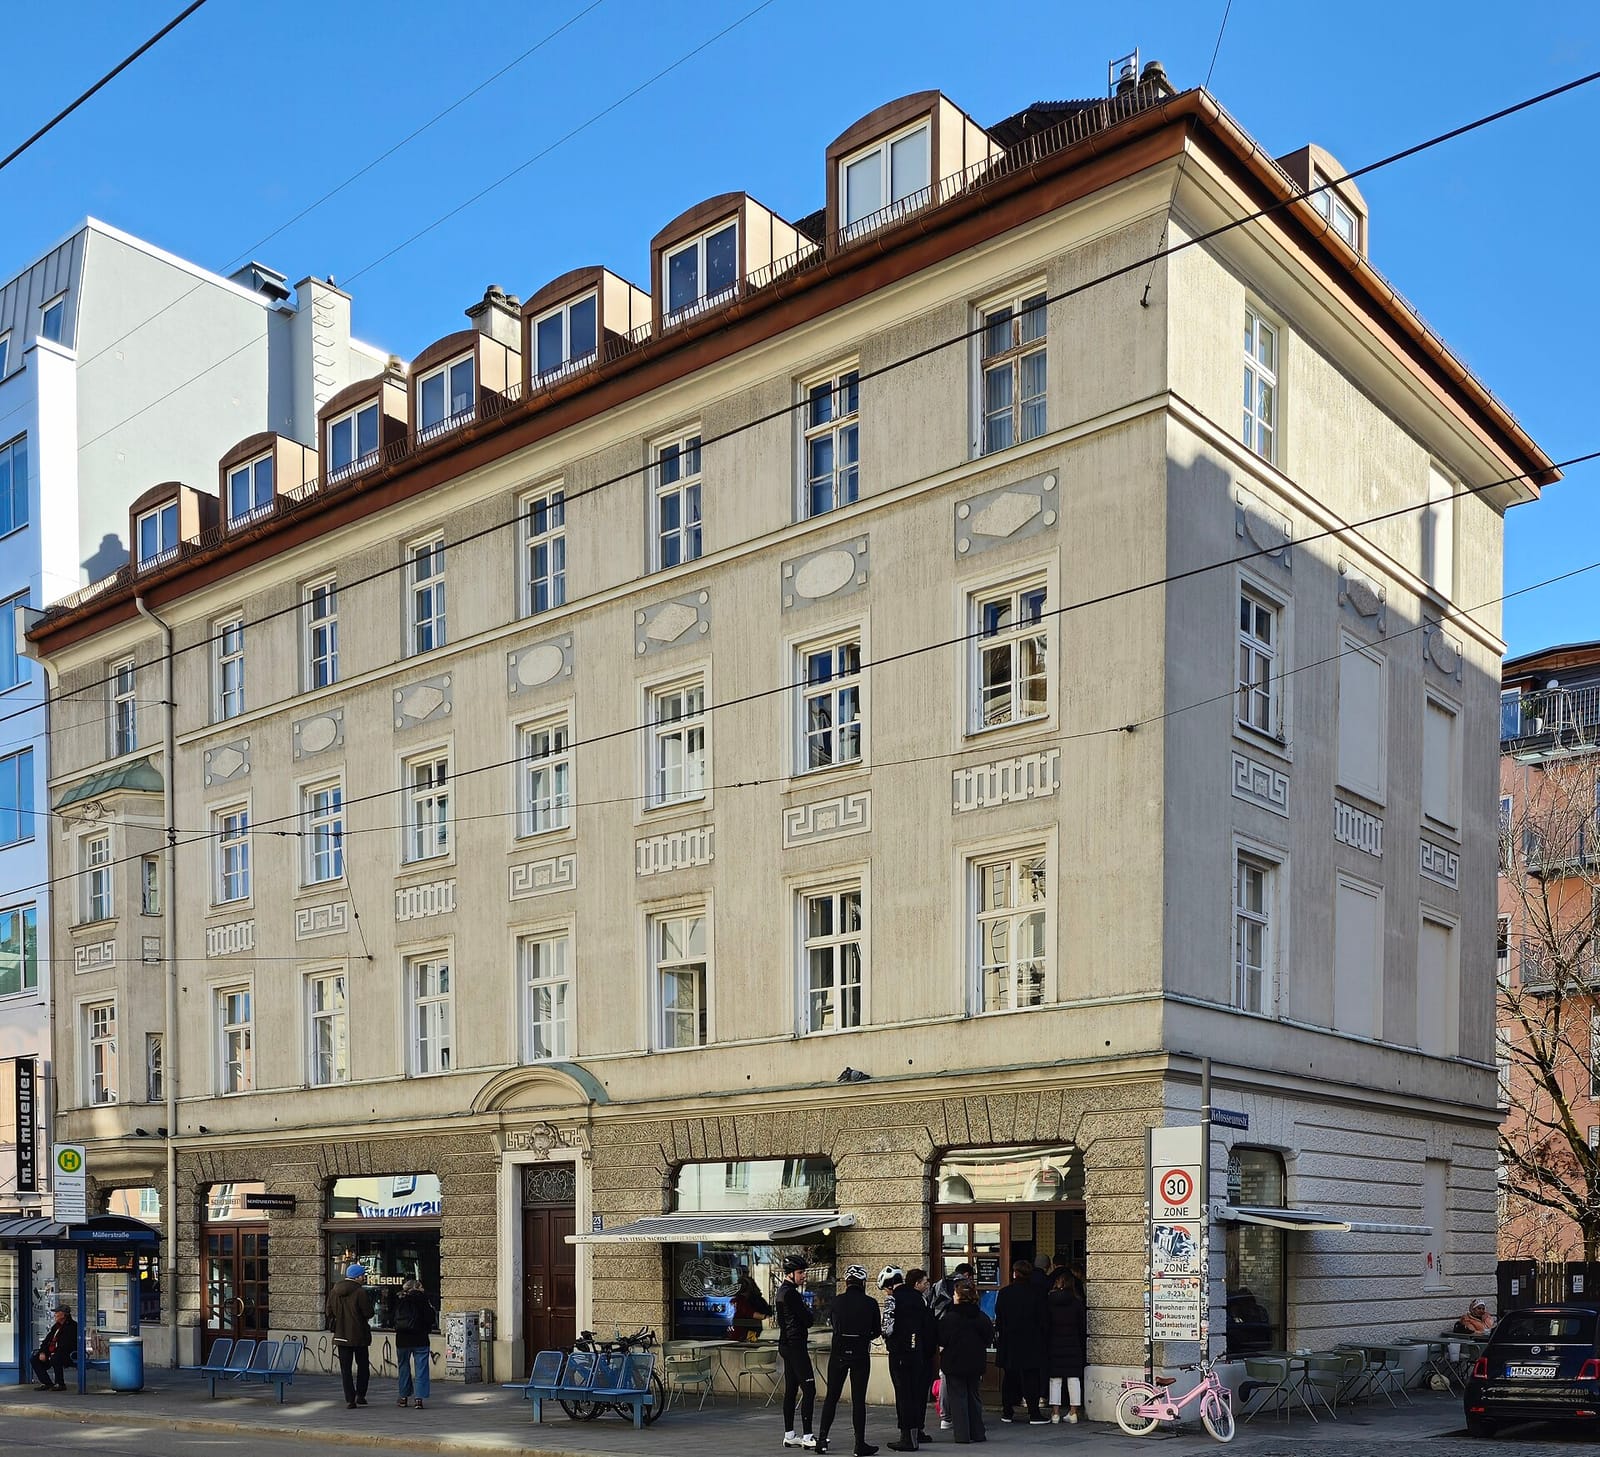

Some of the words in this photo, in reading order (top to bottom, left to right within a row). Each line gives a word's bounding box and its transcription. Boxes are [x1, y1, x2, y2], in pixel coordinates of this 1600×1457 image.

[64, 1154, 75, 1167] H
[1166, 1179, 1186, 1195] 30
[1164, 1207, 1189, 1217] ZONE
[1164, 1263, 1189, 1272] ZONE
[1187, 1303, 1198, 1311] mit
